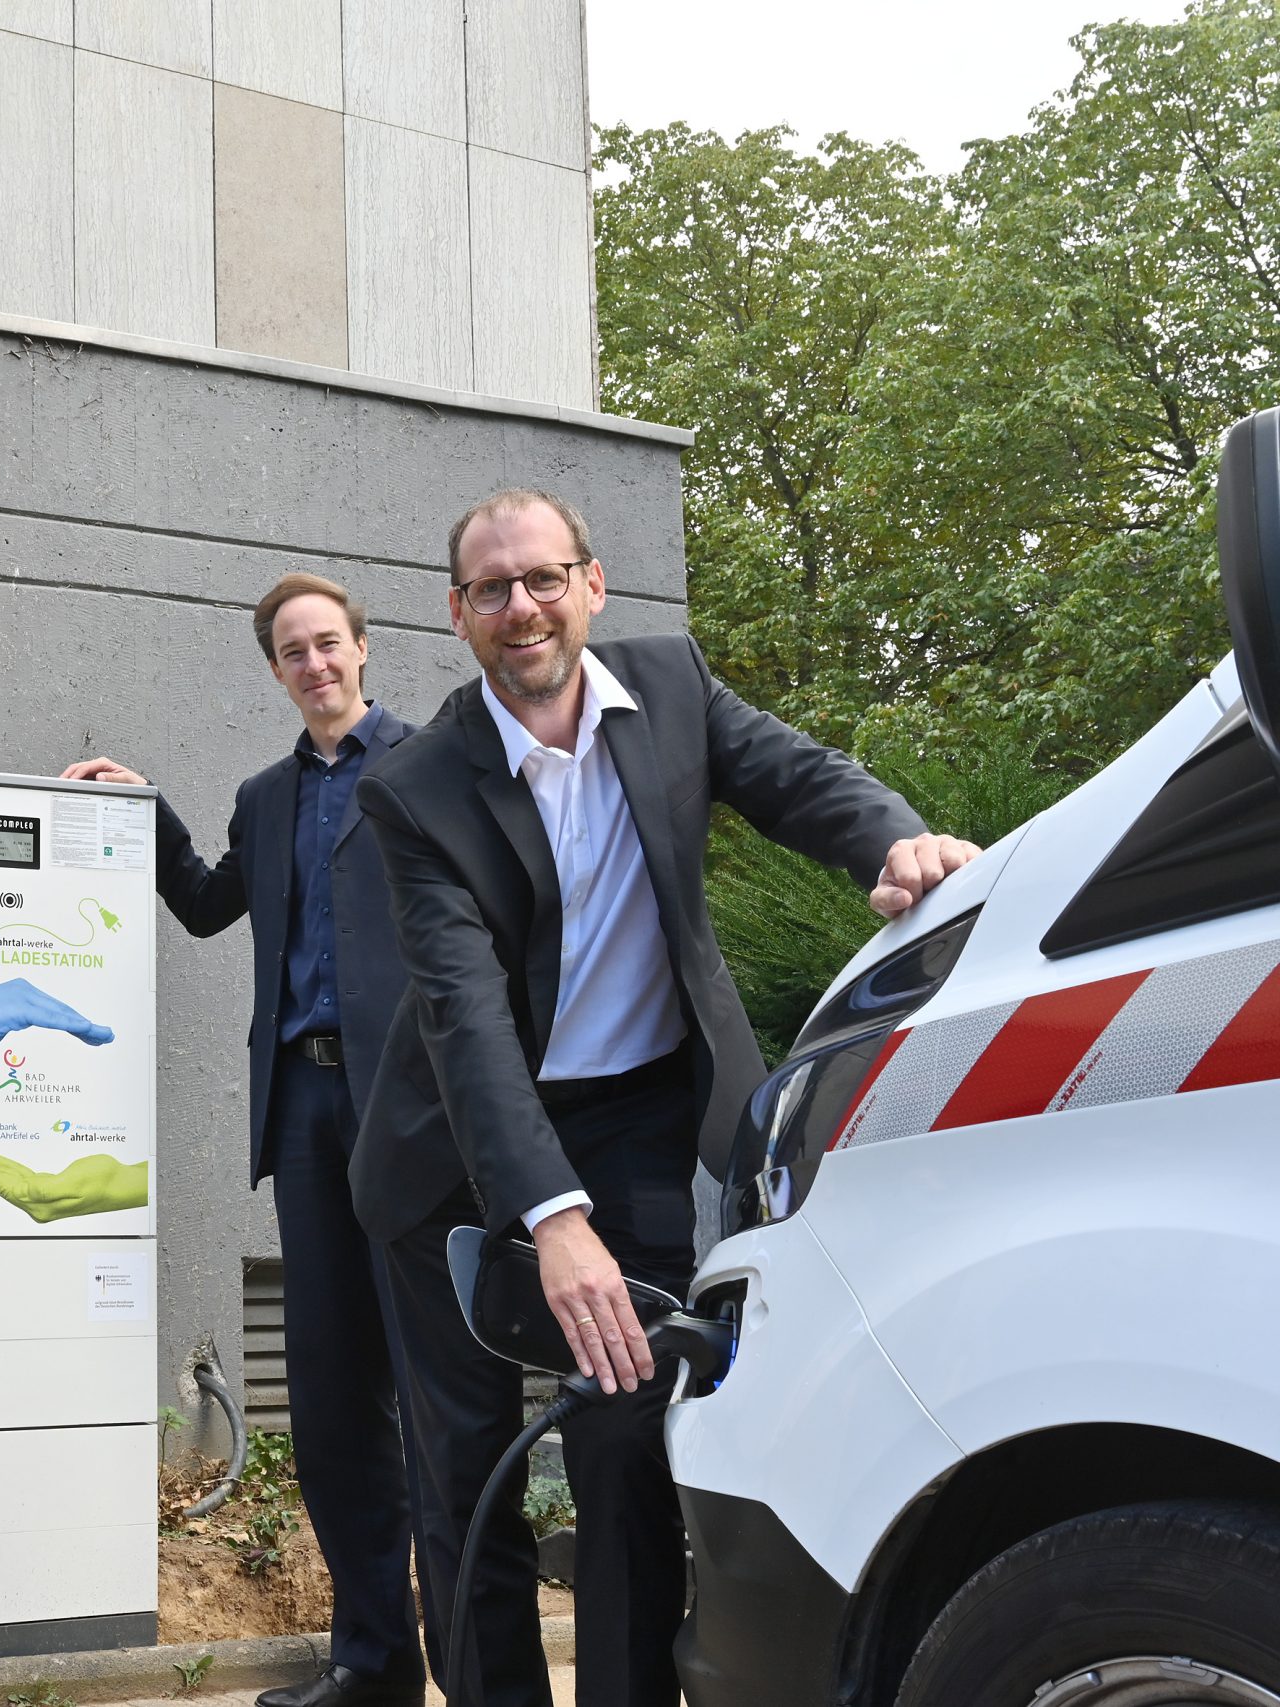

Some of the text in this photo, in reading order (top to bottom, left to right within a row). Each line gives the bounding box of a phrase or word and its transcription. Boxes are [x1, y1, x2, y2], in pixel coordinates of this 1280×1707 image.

[25, 1073, 46, 1082] BAD
[25, 1084, 81, 1093] NEUENAHR
[4, 1095, 62, 1104] AHRWEILER
[29, 1132, 40, 1140] eG
[70, 1132, 126, 1143] ahrtal-werke
